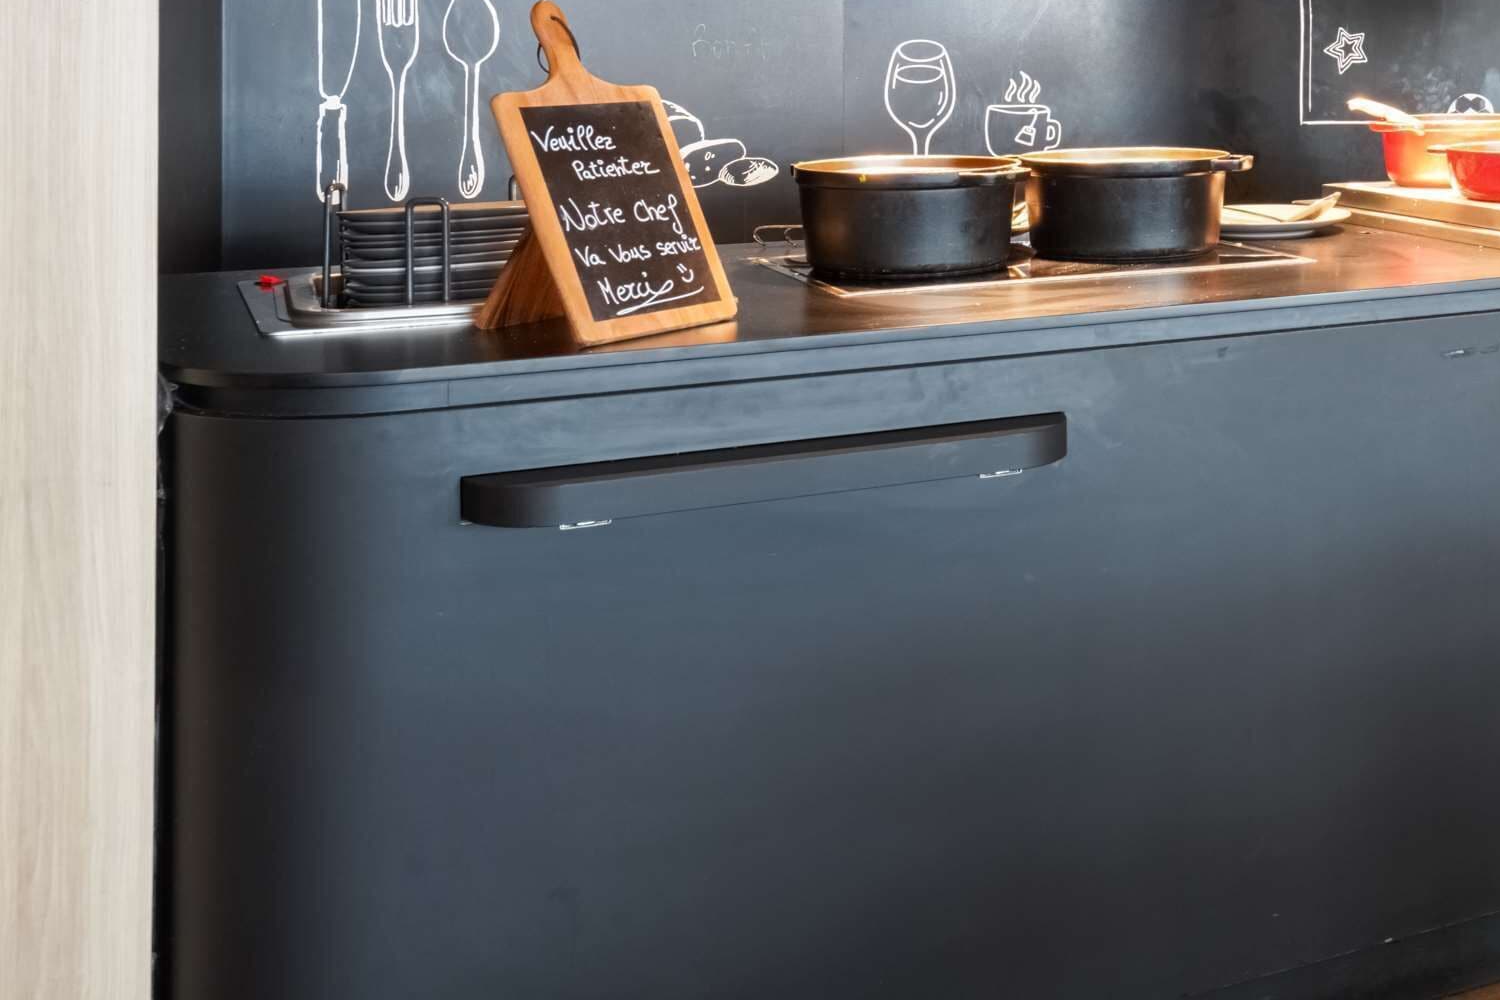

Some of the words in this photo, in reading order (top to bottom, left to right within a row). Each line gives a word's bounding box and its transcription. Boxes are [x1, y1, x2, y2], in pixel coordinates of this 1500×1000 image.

[530, 125, 616, 152] Veuillez
[571, 156, 660, 181] Patienter
[560, 198, 626, 232] Notre
[633, 194, 684, 234] Chef
[656, 234, 701, 256] servir
[597, 271, 674, 305] Merci
